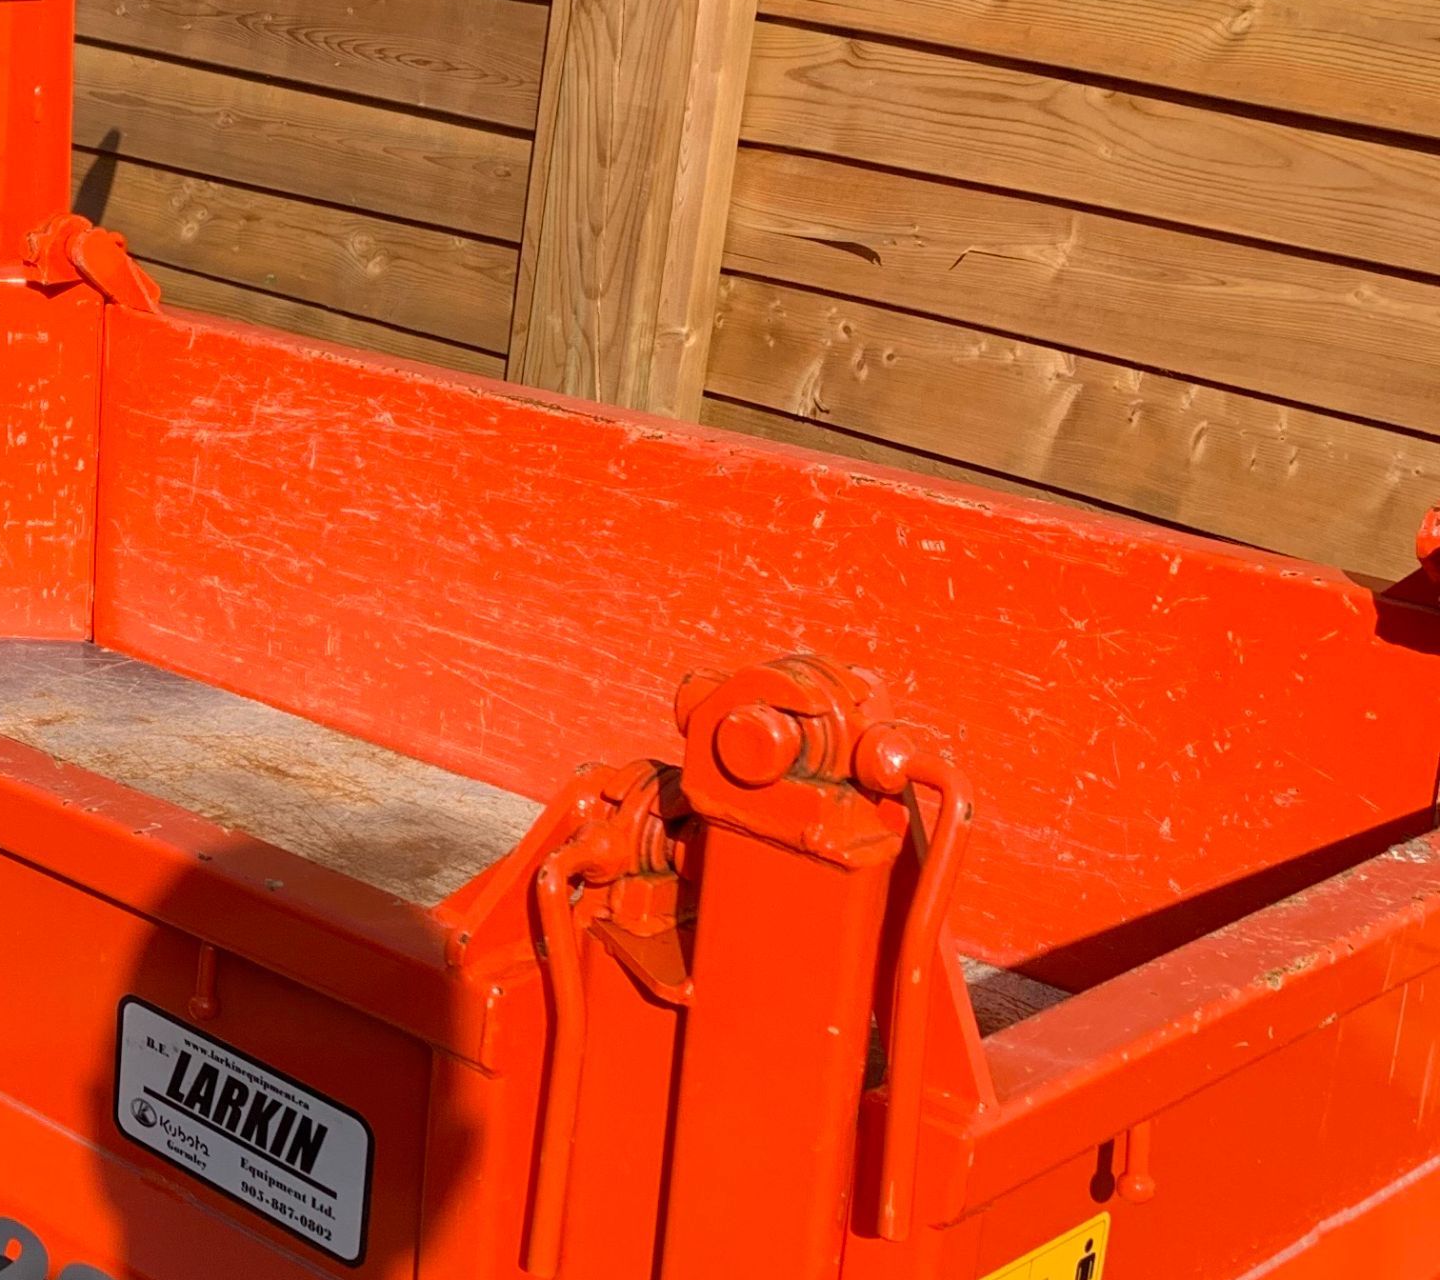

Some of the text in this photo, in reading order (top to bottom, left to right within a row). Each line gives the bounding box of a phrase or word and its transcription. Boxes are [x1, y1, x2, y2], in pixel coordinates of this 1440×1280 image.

[183, 1038, 310, 1111] www.larkinequipment.ca
[159, 1114, 210, 1157] Kubota
[165, 1050, 328, 1175] LARKIN
[166, 1139, 207, 1171] Gormley
[240, 1156, 336, 1221] Equipment Ltd.
[240, 1180, 332, 1241] 905-887-0802
